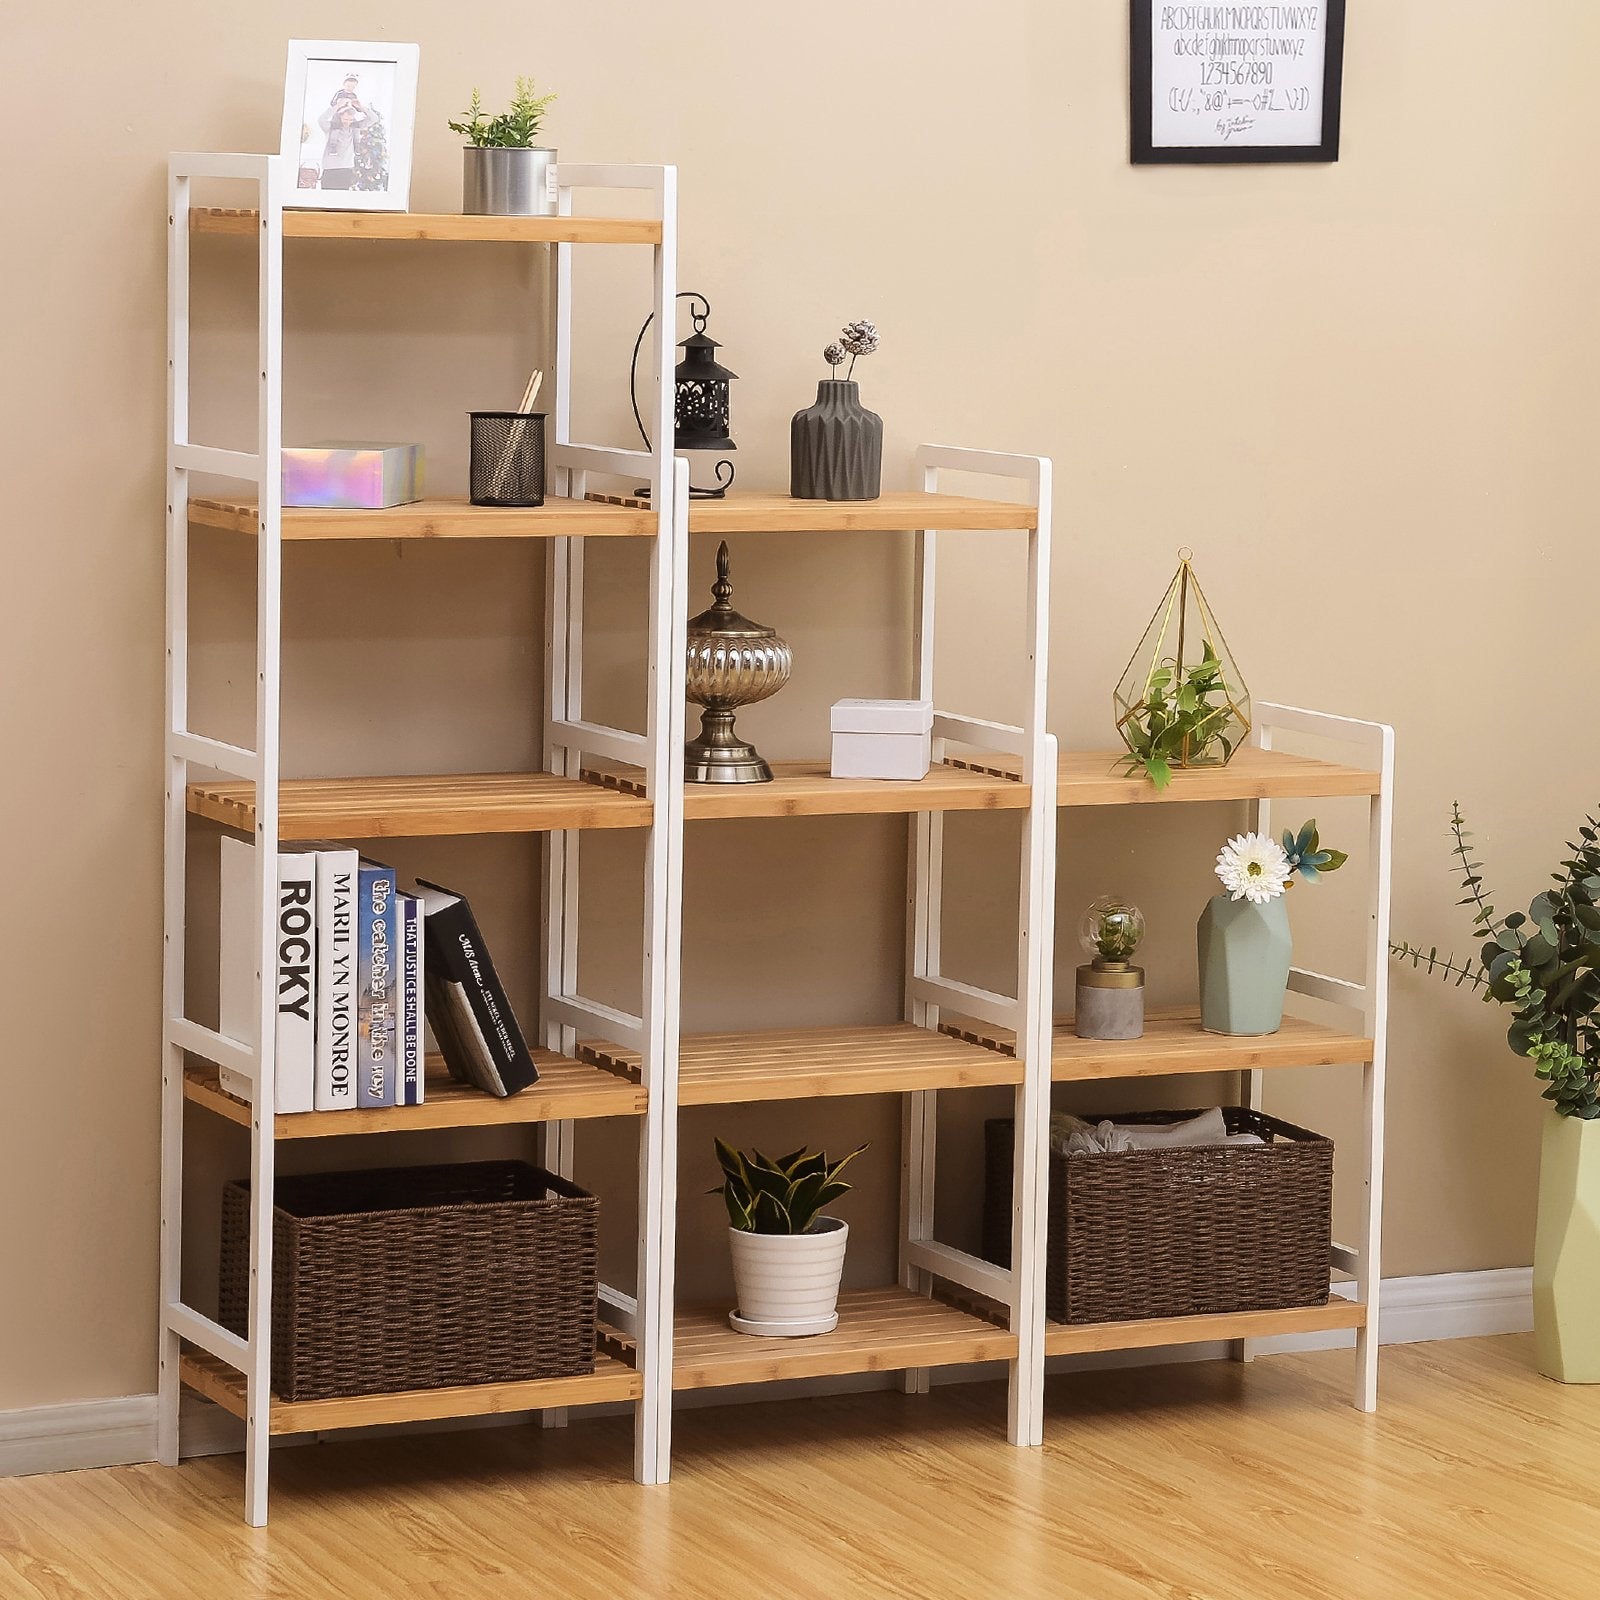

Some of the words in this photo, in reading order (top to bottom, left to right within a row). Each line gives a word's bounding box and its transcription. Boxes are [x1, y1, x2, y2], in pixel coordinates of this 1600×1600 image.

[1200, 61, 1273, 86] 1234567890
[372, 880, 390, 915] the
[332, 873, 350, 986] MARILYN
[406, 917, 417, 947] THAT
[279, 880, 312, 1021] ROCKY
[371, 918, 389, 999] catcher
[406, 949, 417, 994] JUSTICE
[405, 997, 416, 1033] SHALL
[331, 992, 350, 1097] MONROE
[405, 1034, 416, 1048] BE
[405, 1050, 416, 1083] DONE
